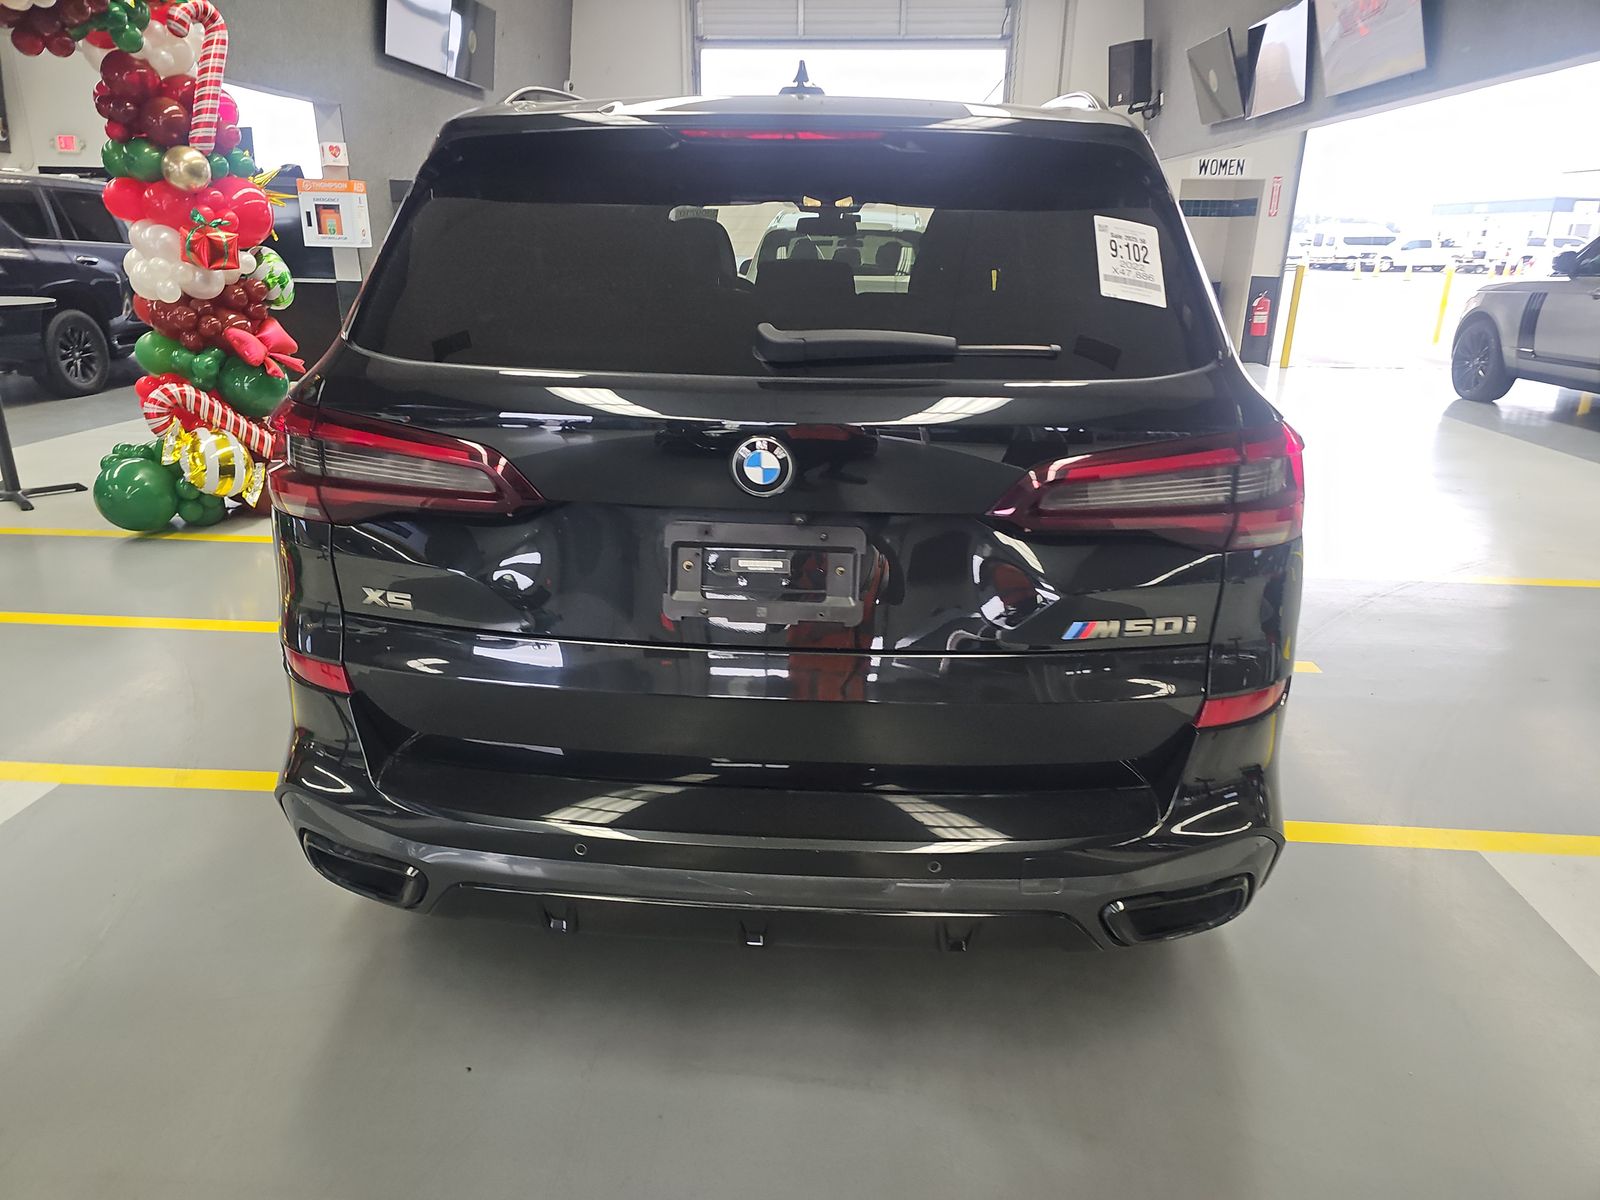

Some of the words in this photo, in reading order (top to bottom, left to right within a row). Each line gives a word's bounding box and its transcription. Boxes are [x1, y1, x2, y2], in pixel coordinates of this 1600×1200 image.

[1198, 158, 1246, 176] WOMEN
[1109, 239, 1150, 264] 9:102
[1119, 260, 1146, 272] 2022
[361, 586, 414, 611] X5
[1088, 615, 1198, 639] M50i
